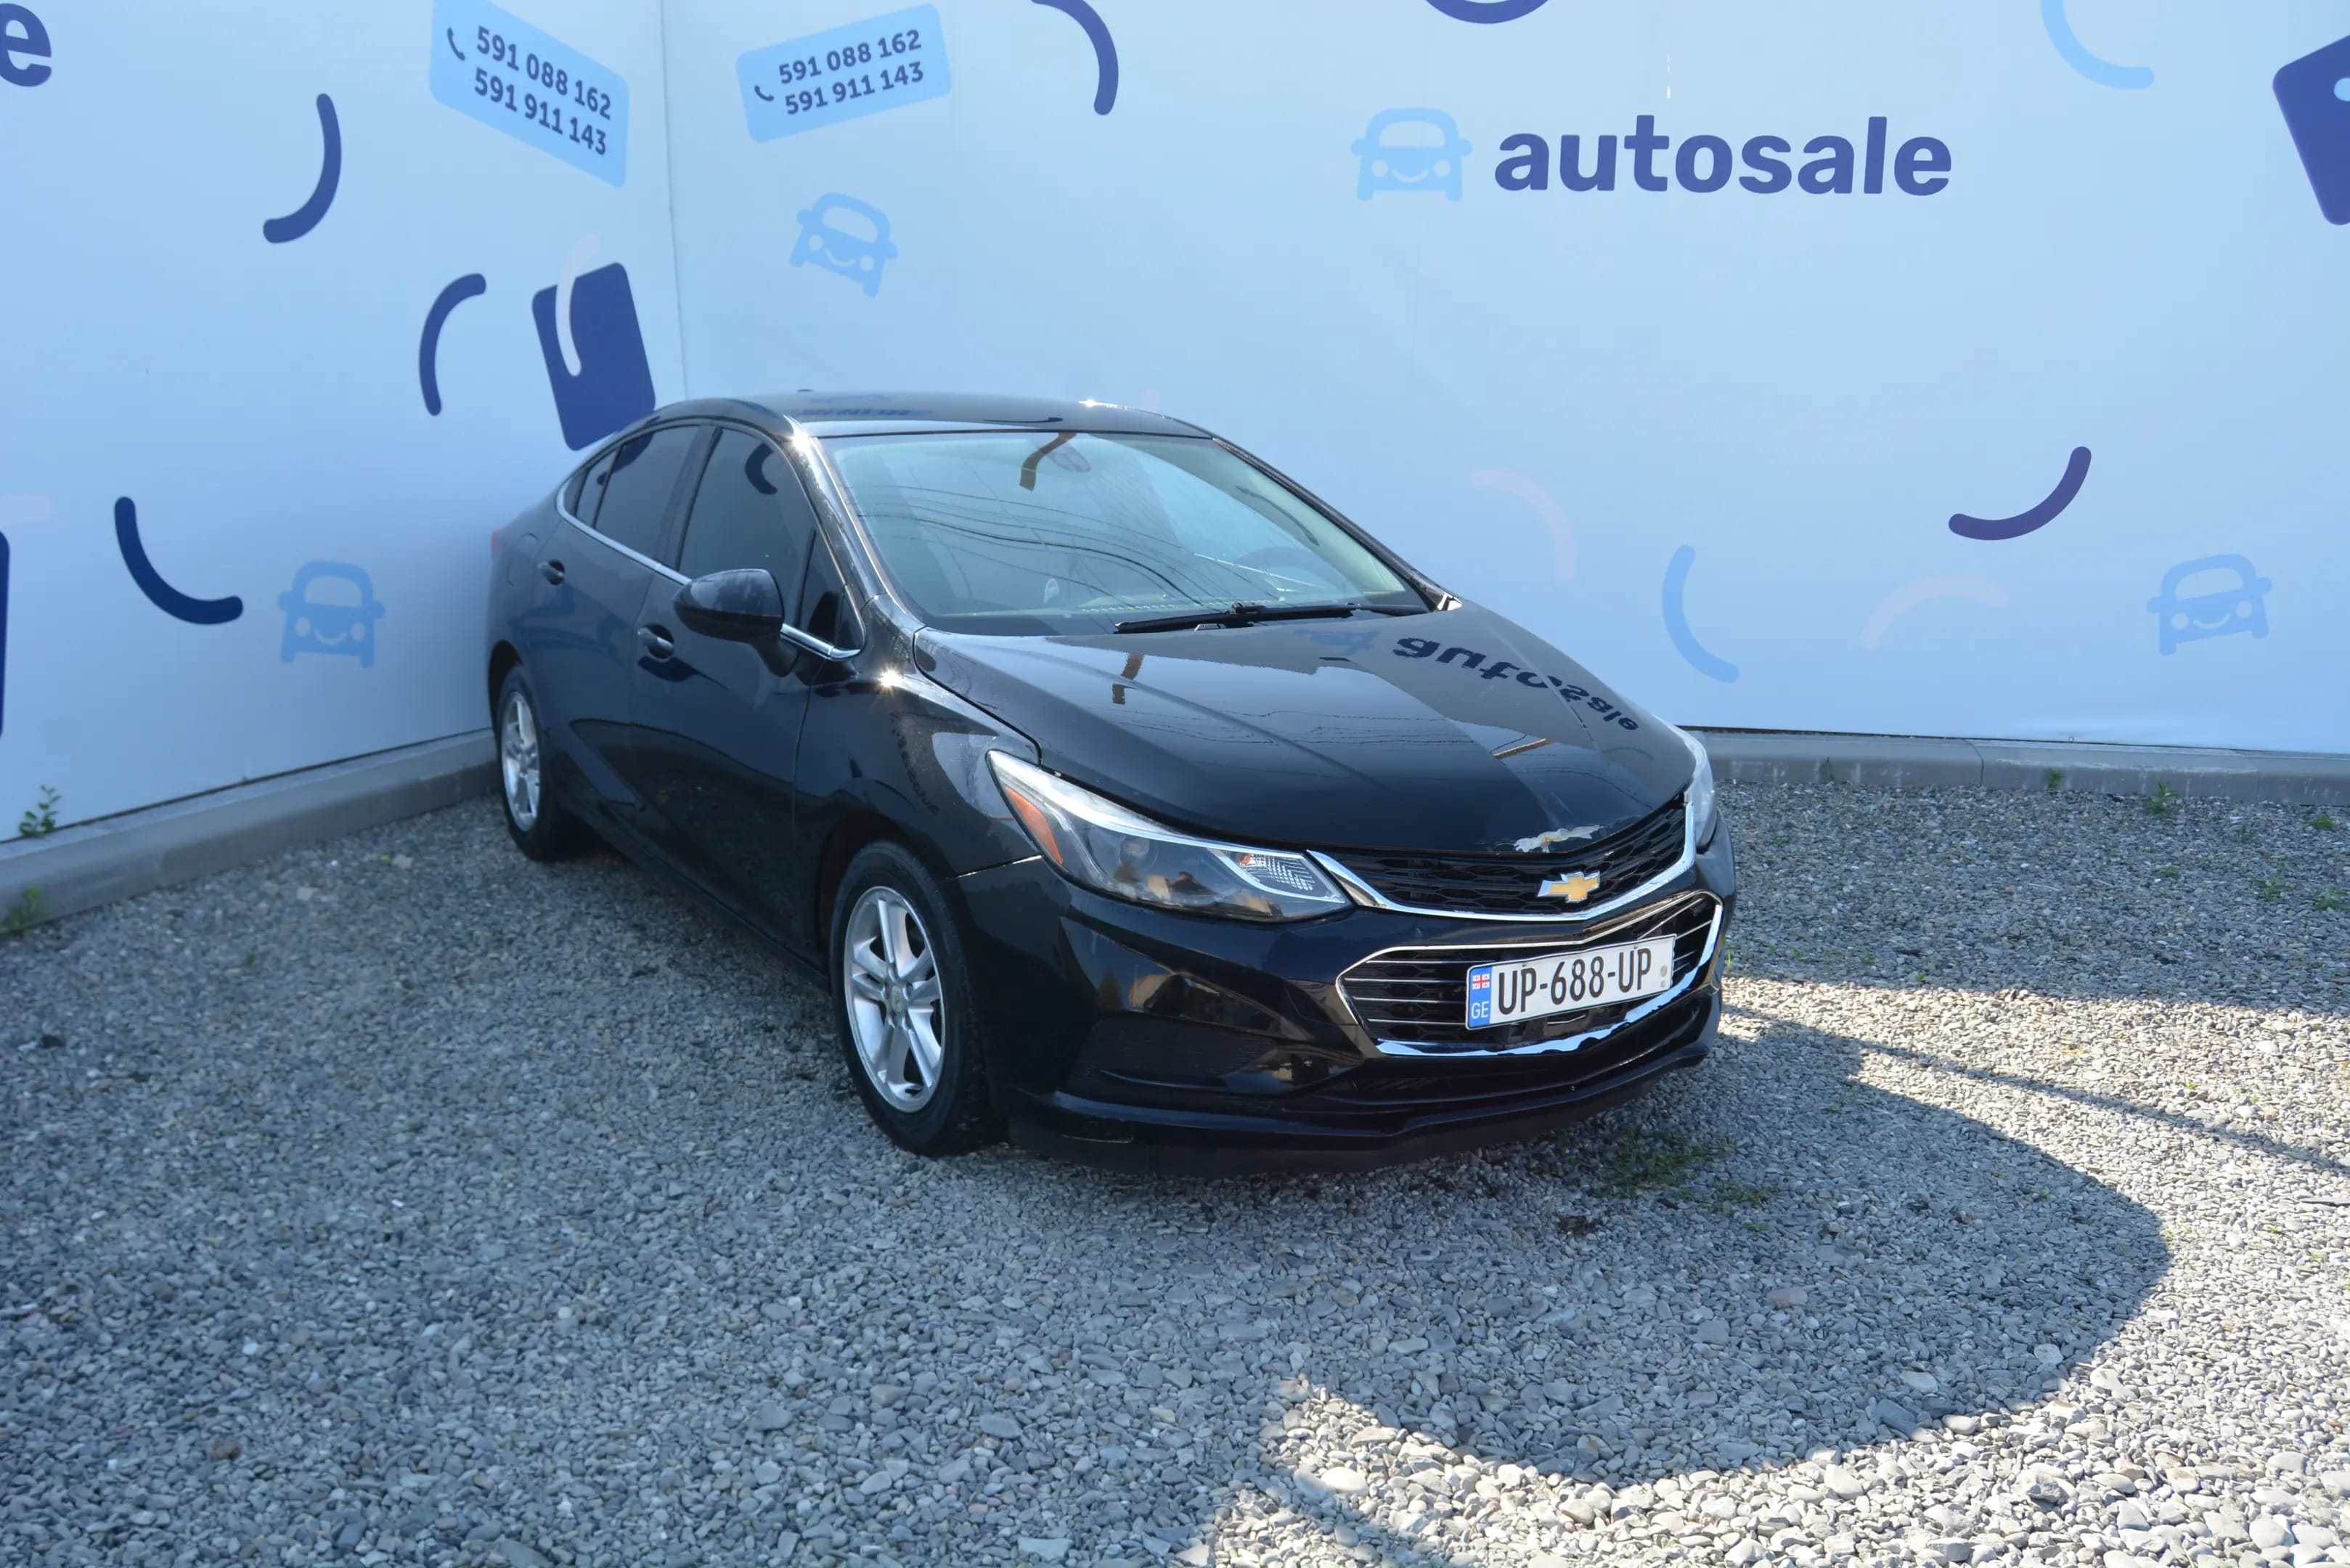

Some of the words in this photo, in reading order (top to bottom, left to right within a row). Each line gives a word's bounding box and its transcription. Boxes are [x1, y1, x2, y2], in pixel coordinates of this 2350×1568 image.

[477, 25, 519, 71] 591
[526, 53, 568, 96] 088
[574, 79, 611, 121] 162
[779, 56, 822, 84] 591
[826, 42, 871, 71] 088
[878, 29, 921, 58] 162
[785, 87, 828, 115] 591
[832, 74, 875, 102] 911
[881, 61, 923, 90] 143
[475, 67, 517, 113] 591
[524, 93, 563, 135] 911
[569, 117, 605, 155] 143
[1494, 114, 1952, 196] autosale
[1471, 1000, 1490, 1020] GE
[1498, 948, 1652, 1016] UP-688-UP
